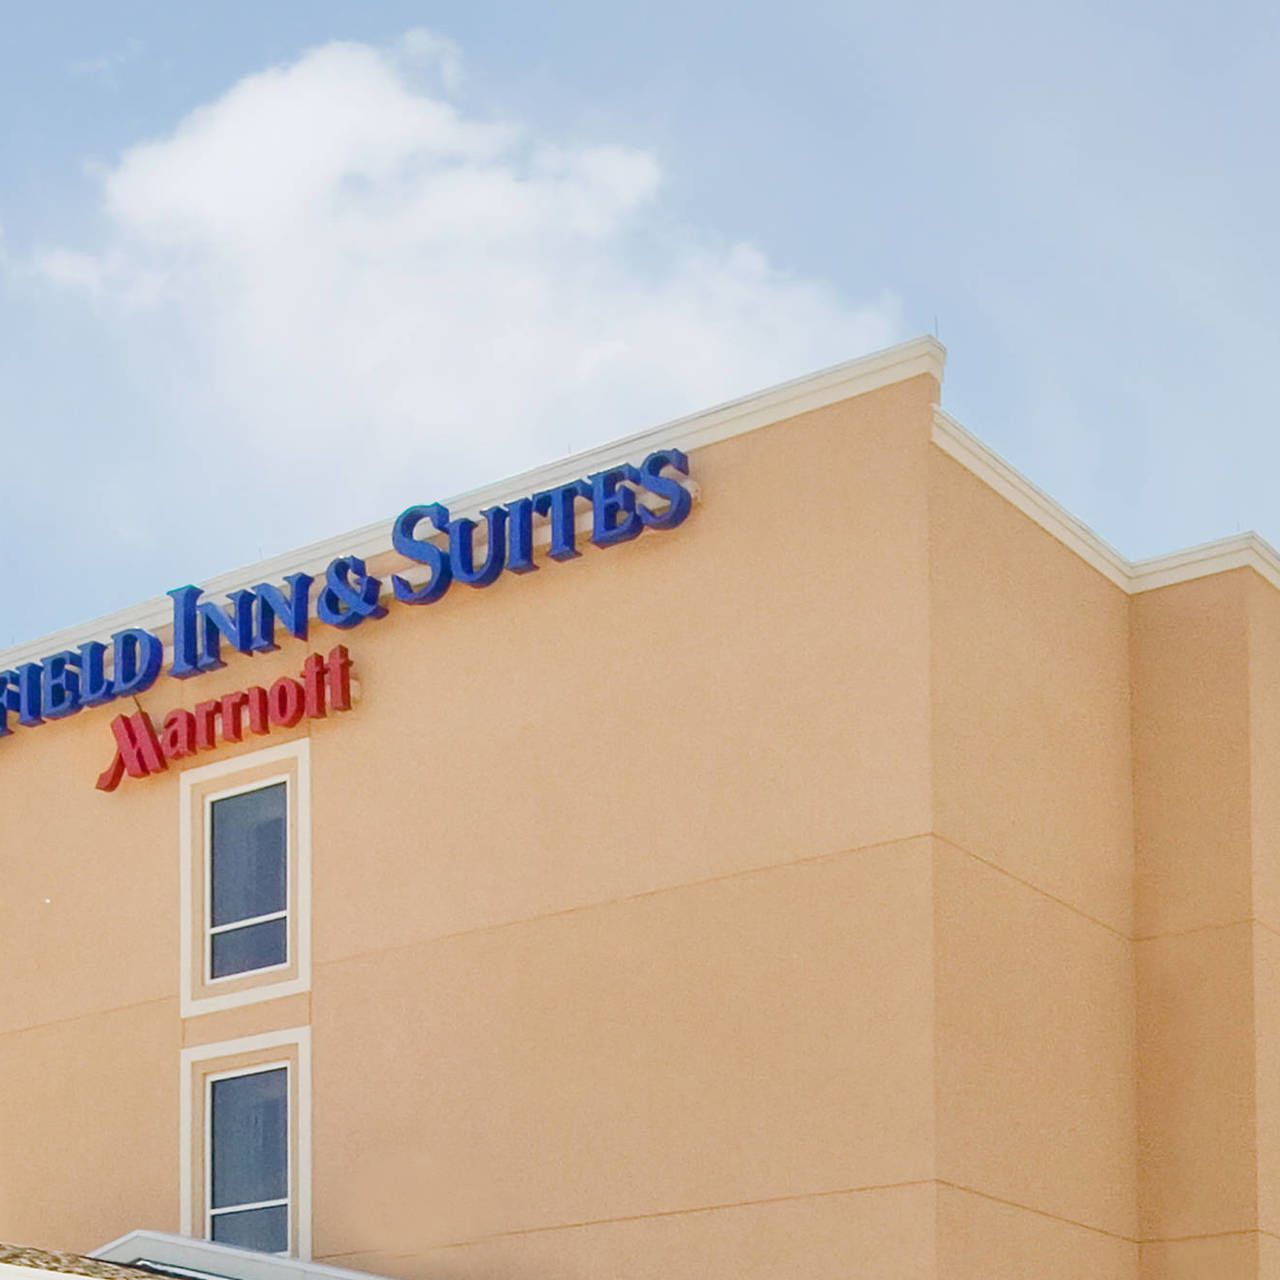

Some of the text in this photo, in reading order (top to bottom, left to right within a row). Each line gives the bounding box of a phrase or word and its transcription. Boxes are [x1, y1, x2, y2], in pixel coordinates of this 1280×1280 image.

[166, 571, 316, 680] INN
[317, 554, 390, 629] &
[392, 447, 693, 606] SUITES
[96, 644, 354, 792] Marriott
